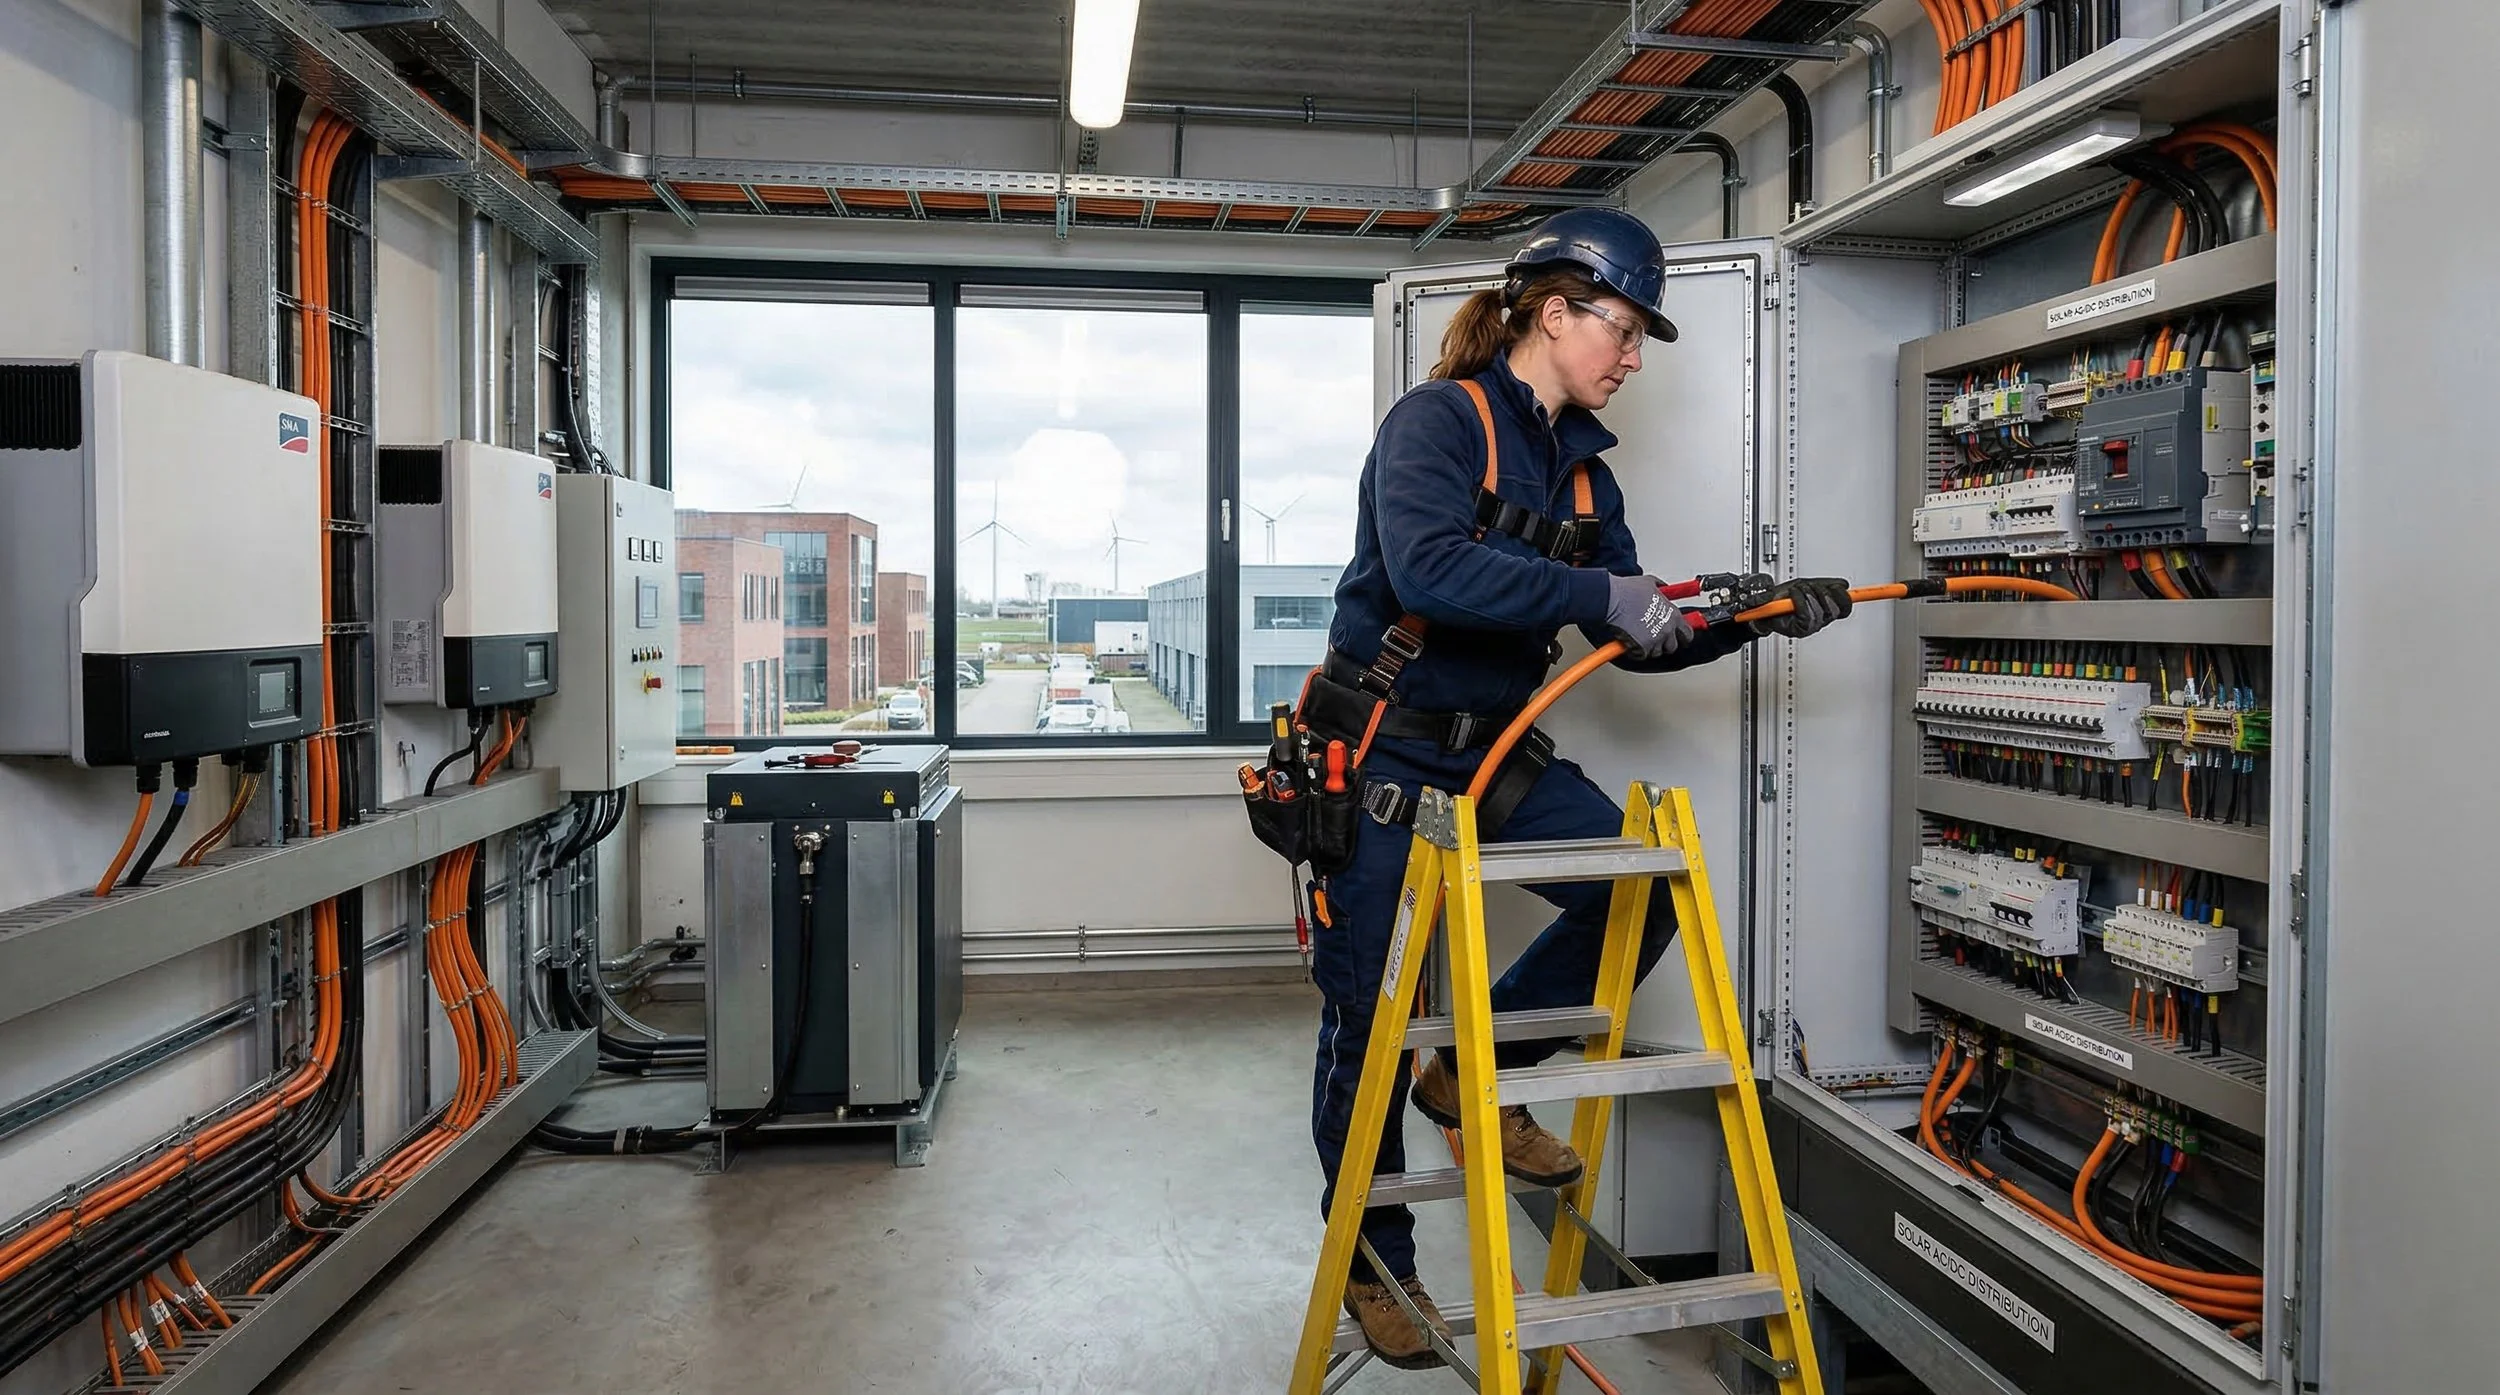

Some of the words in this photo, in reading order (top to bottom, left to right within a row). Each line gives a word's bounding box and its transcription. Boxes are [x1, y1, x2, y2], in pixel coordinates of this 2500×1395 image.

[2077, 1037, 2125, 1063] DISTRIBUTION
[1897, 1222, 1931, 1253] SOLAR
[1968, 1271, 2049, 1341] DISTRIBUTION
